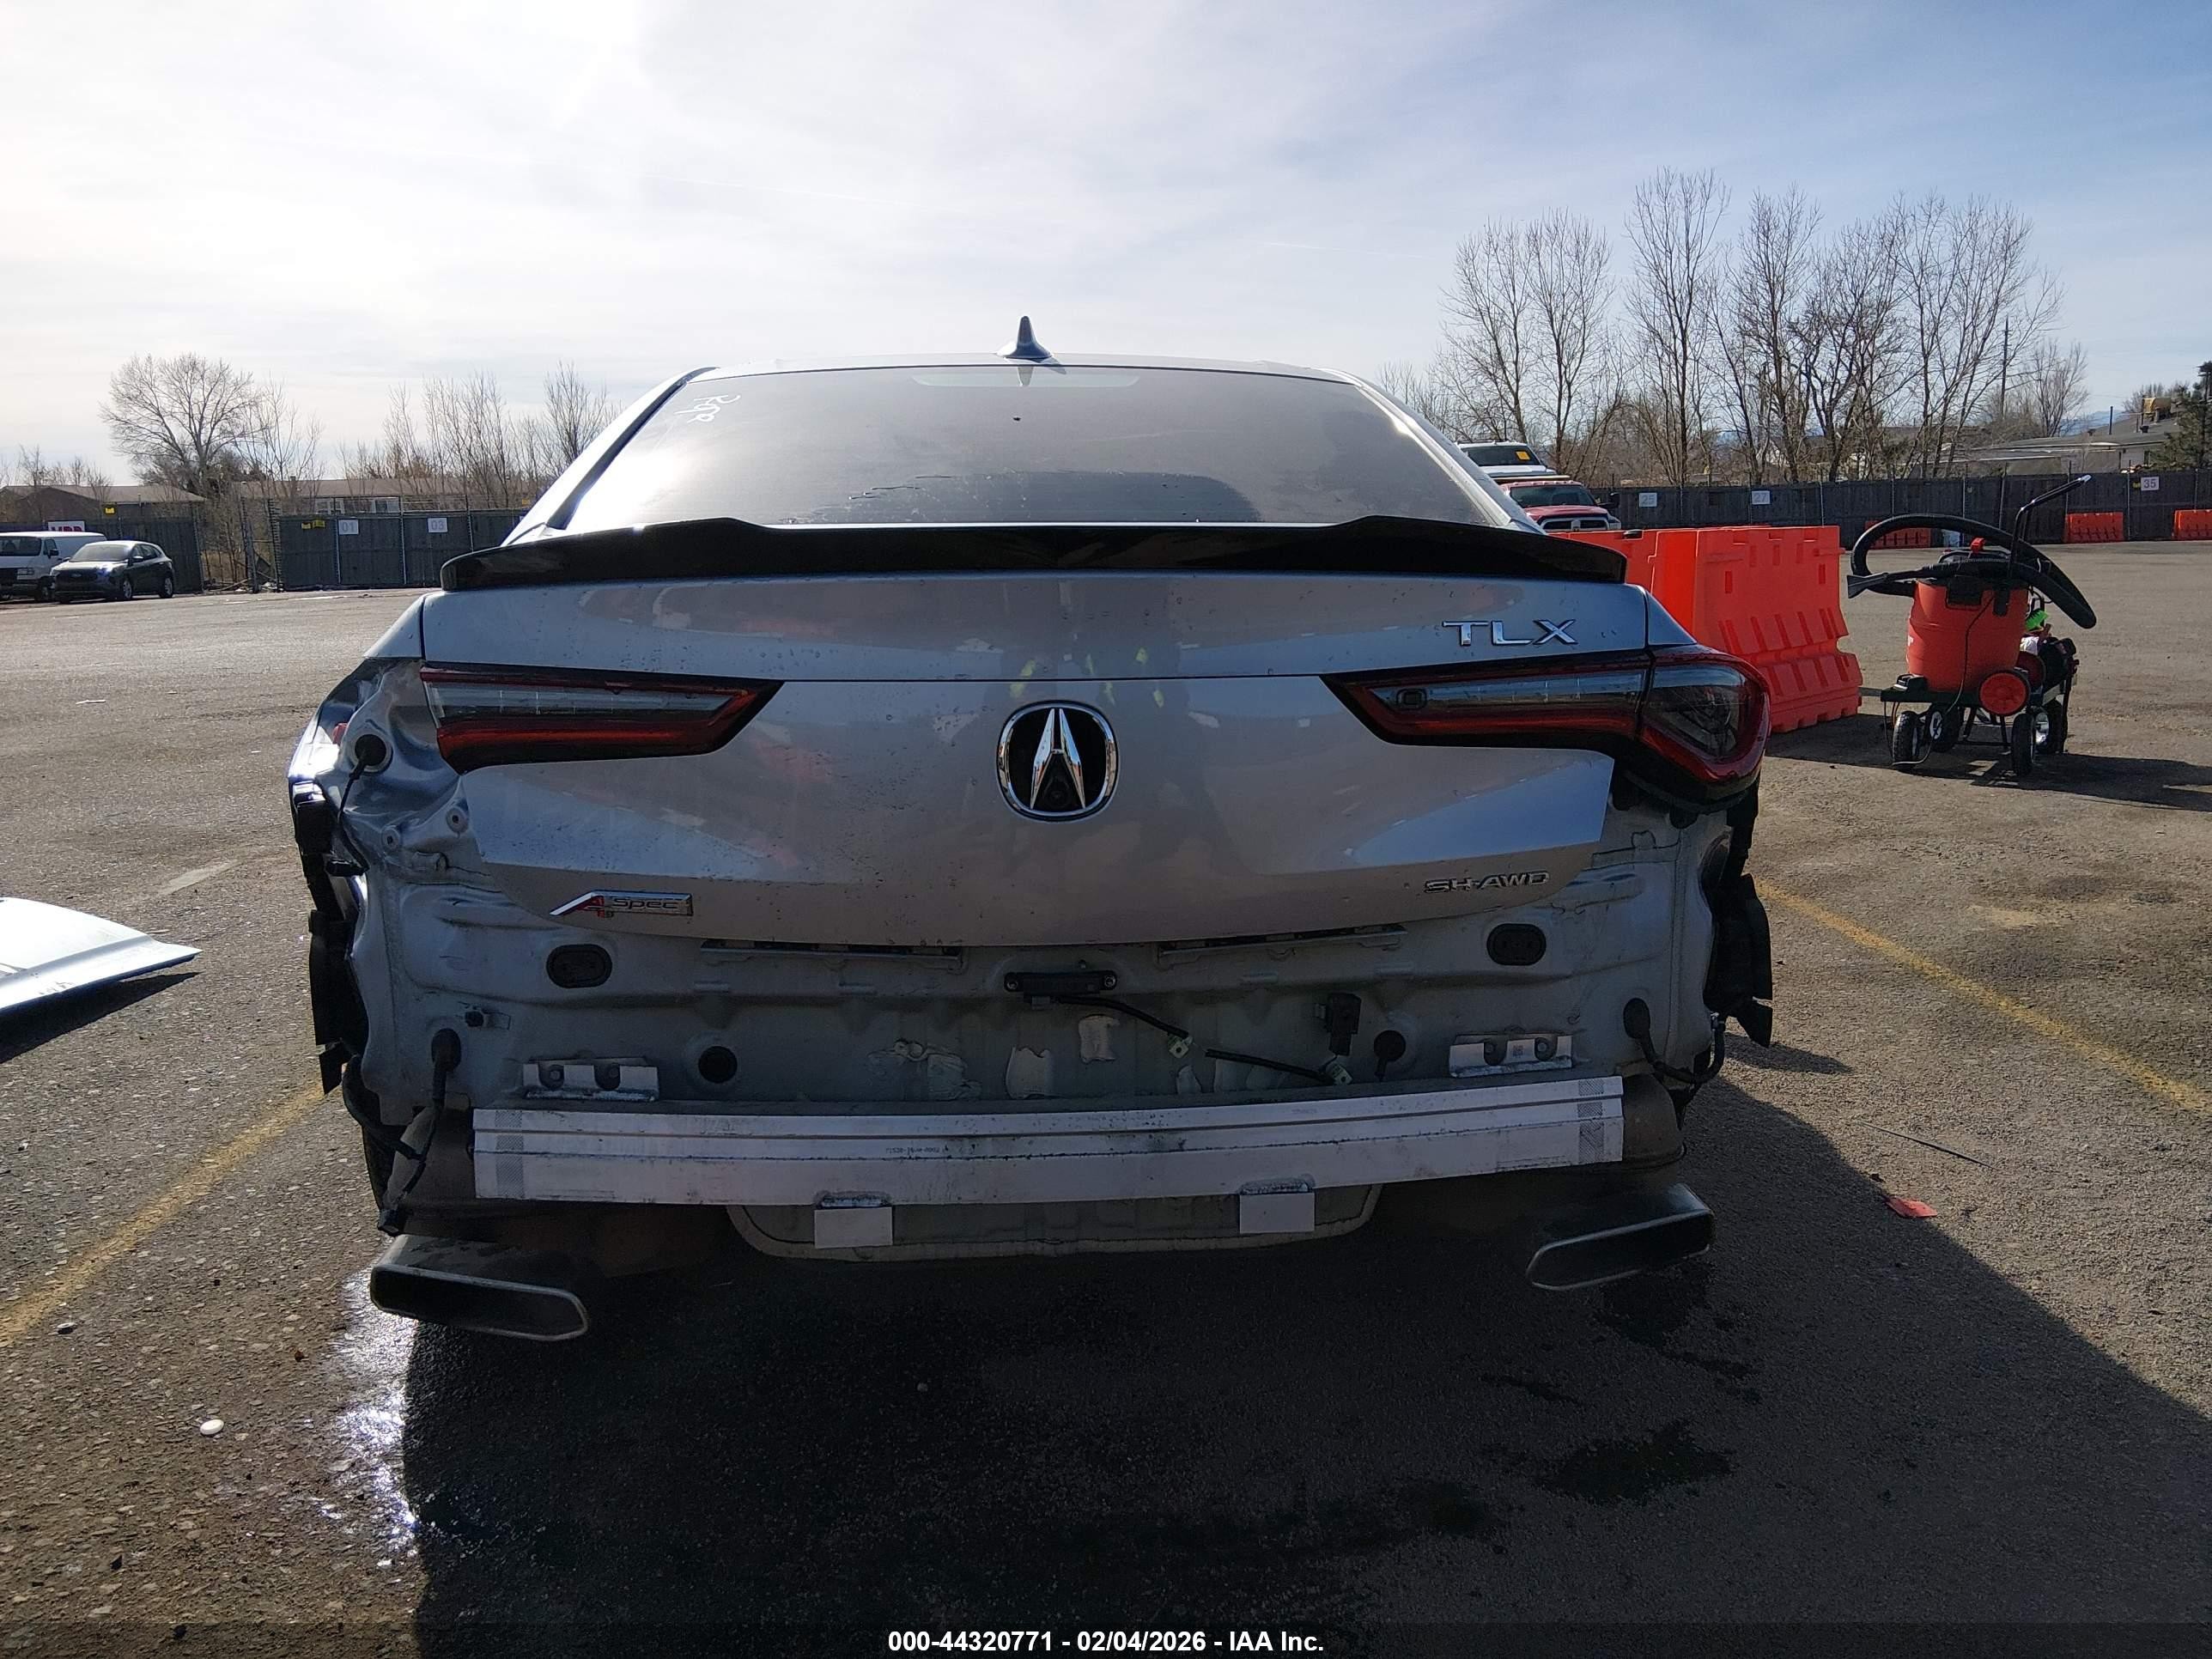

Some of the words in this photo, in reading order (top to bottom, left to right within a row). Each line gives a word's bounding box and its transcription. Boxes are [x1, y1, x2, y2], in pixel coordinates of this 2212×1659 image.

[2143, 478, 2156, 489] 35
[1641, 494, 1655, 506] 25
[1753, 493, 1767, 503] 27
[342, 521, 355, 532] 01
[430, 520, 444, 531] 03
[1442, 619, 1578, 646] TLX
[1424, 870, 1550, 893] SH-AWD
